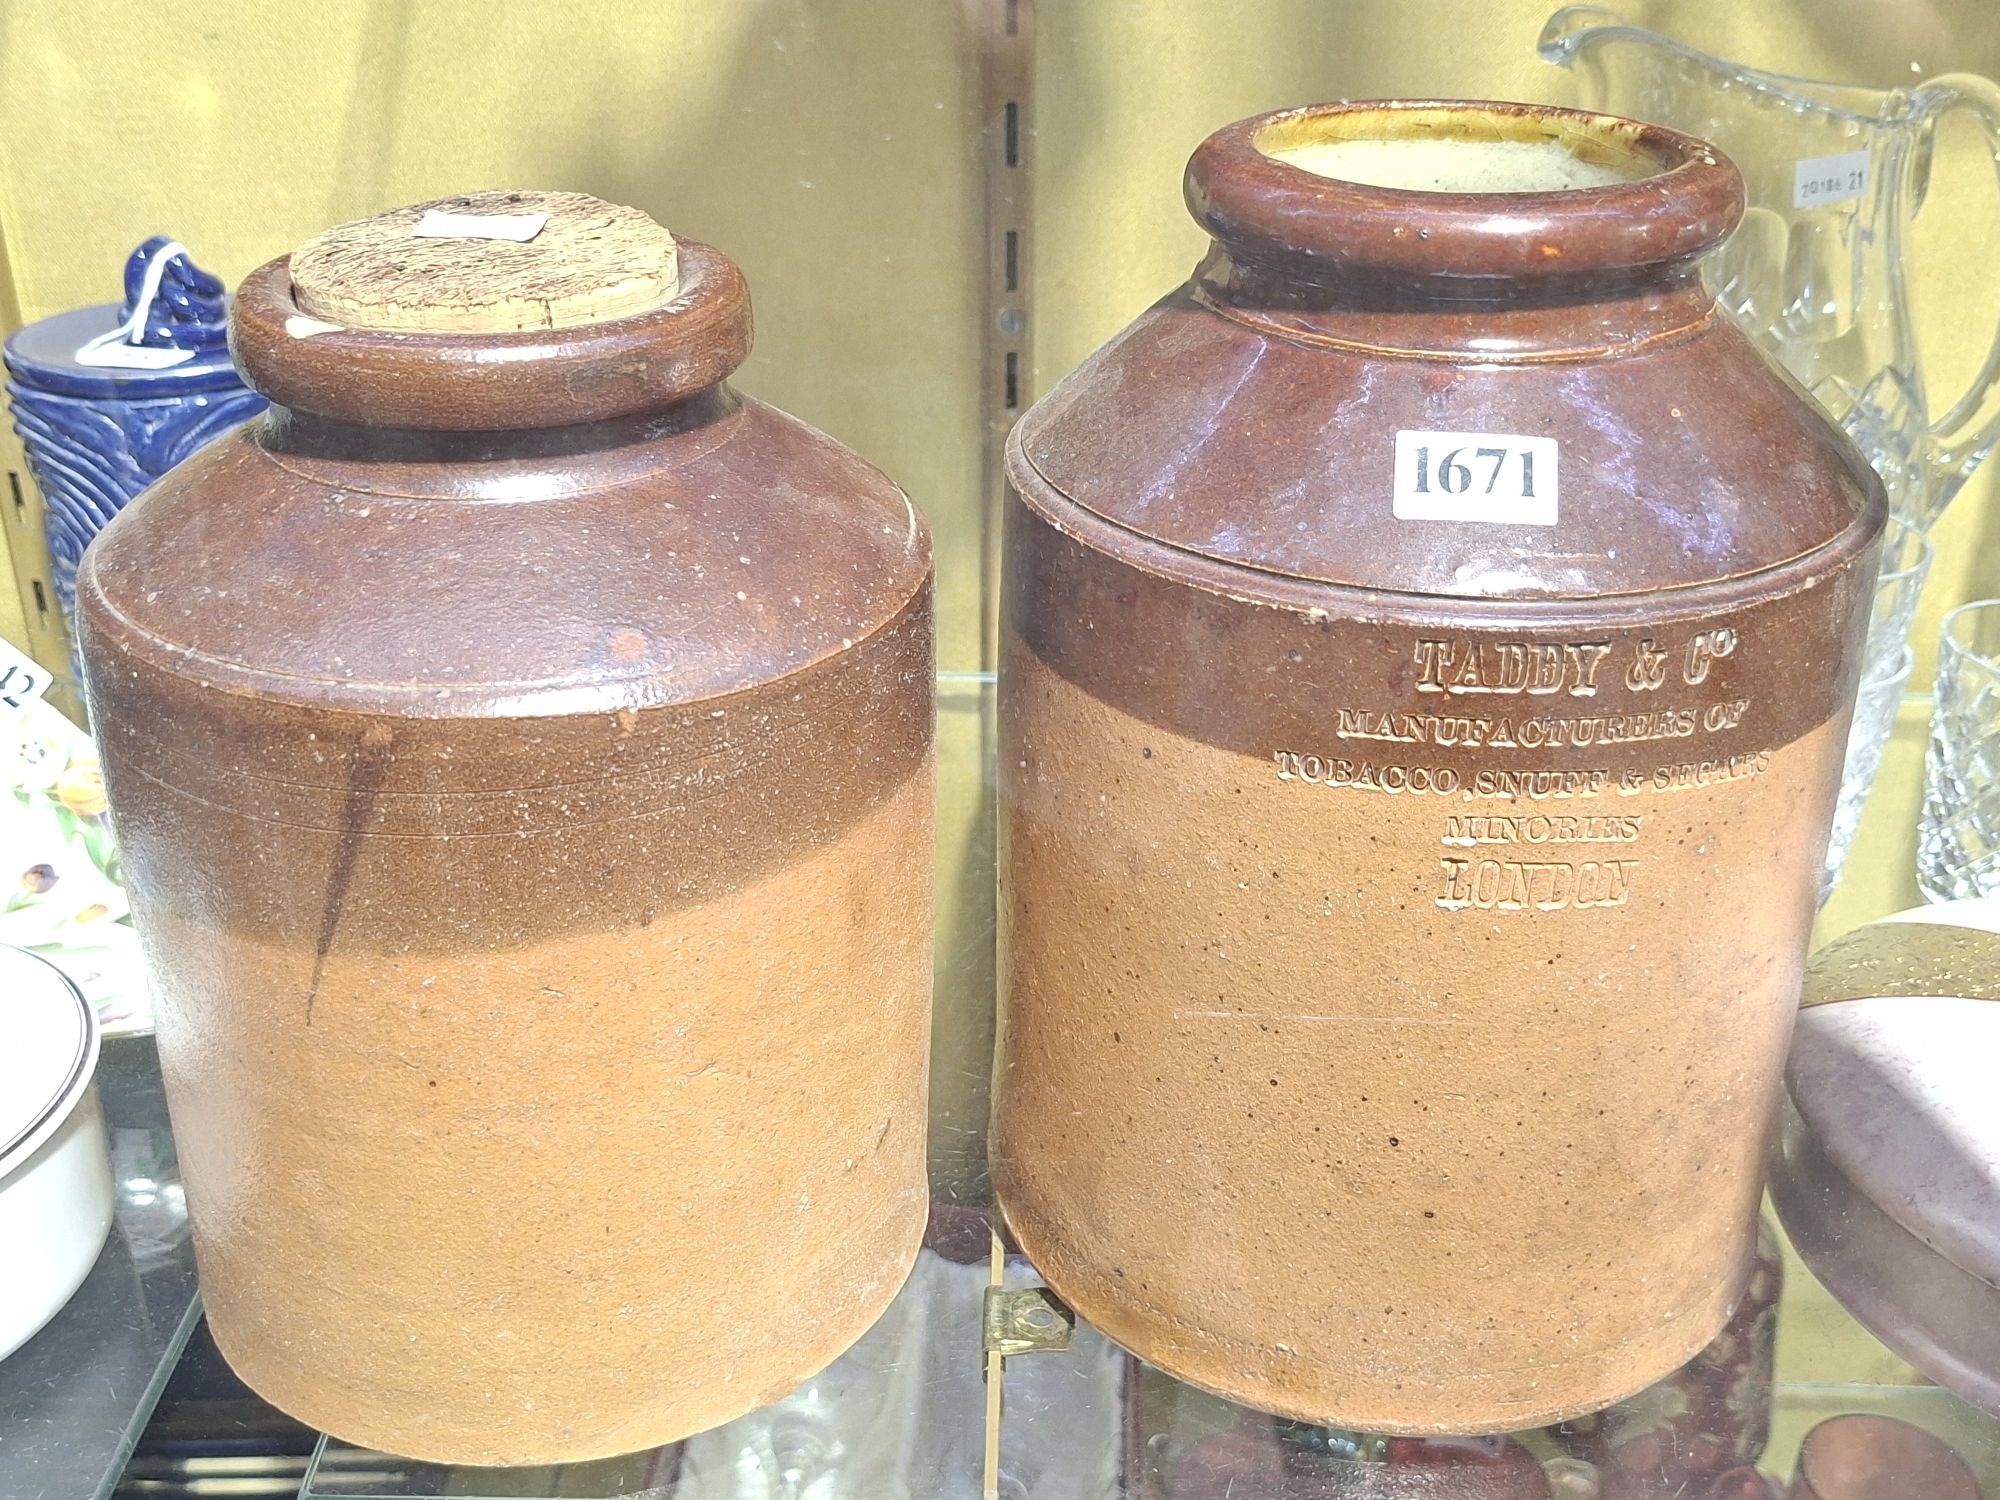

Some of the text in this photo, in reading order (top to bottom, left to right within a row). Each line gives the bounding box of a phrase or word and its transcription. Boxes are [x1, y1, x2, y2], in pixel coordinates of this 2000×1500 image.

[1413, 446, 1536, 498] 1671
[1414, 637, 1611, 697] TADDY
[1626, 638, 1668, 692] &
[1336, 699, 1751, 748] MANUFACTURERS OF
[1475, 769, 1609, 800] SNUFF
[1617, 768, 1645, 797] &
[1441, 815, 1644, 847] MINORIES
[1434, 857, 1640, 912] LONDON
